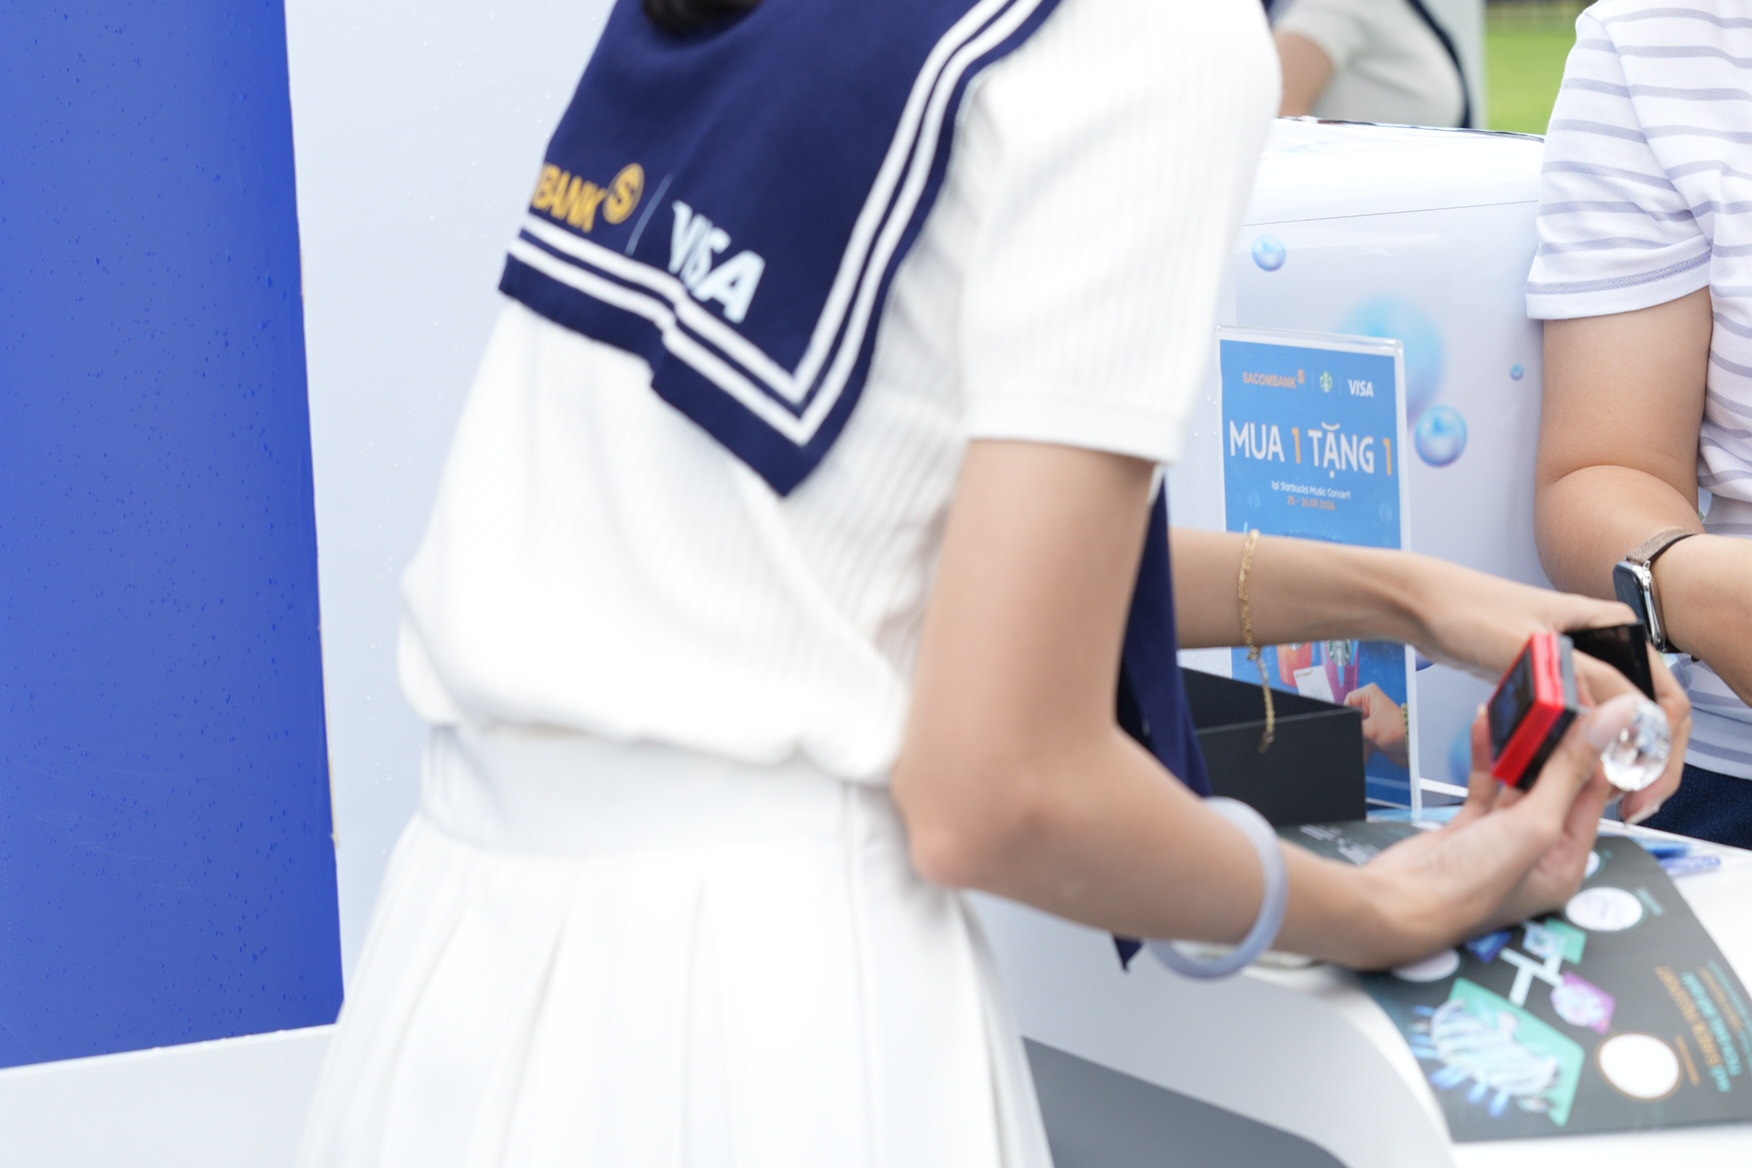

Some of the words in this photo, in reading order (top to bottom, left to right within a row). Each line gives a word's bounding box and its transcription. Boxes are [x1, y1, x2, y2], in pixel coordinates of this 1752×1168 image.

[668, 200, 765, 324] VISA
[1242, 372, 1296, 389] SACOMBANK
[1347, 379, 1374, 398] VISA
[1230, 420, 1285, 462] MUA
[1292, 427, 1302, 464] 1
[1308, 421, 1375, 479] TẶNG
[1383, 438, 1392, 476] 1
